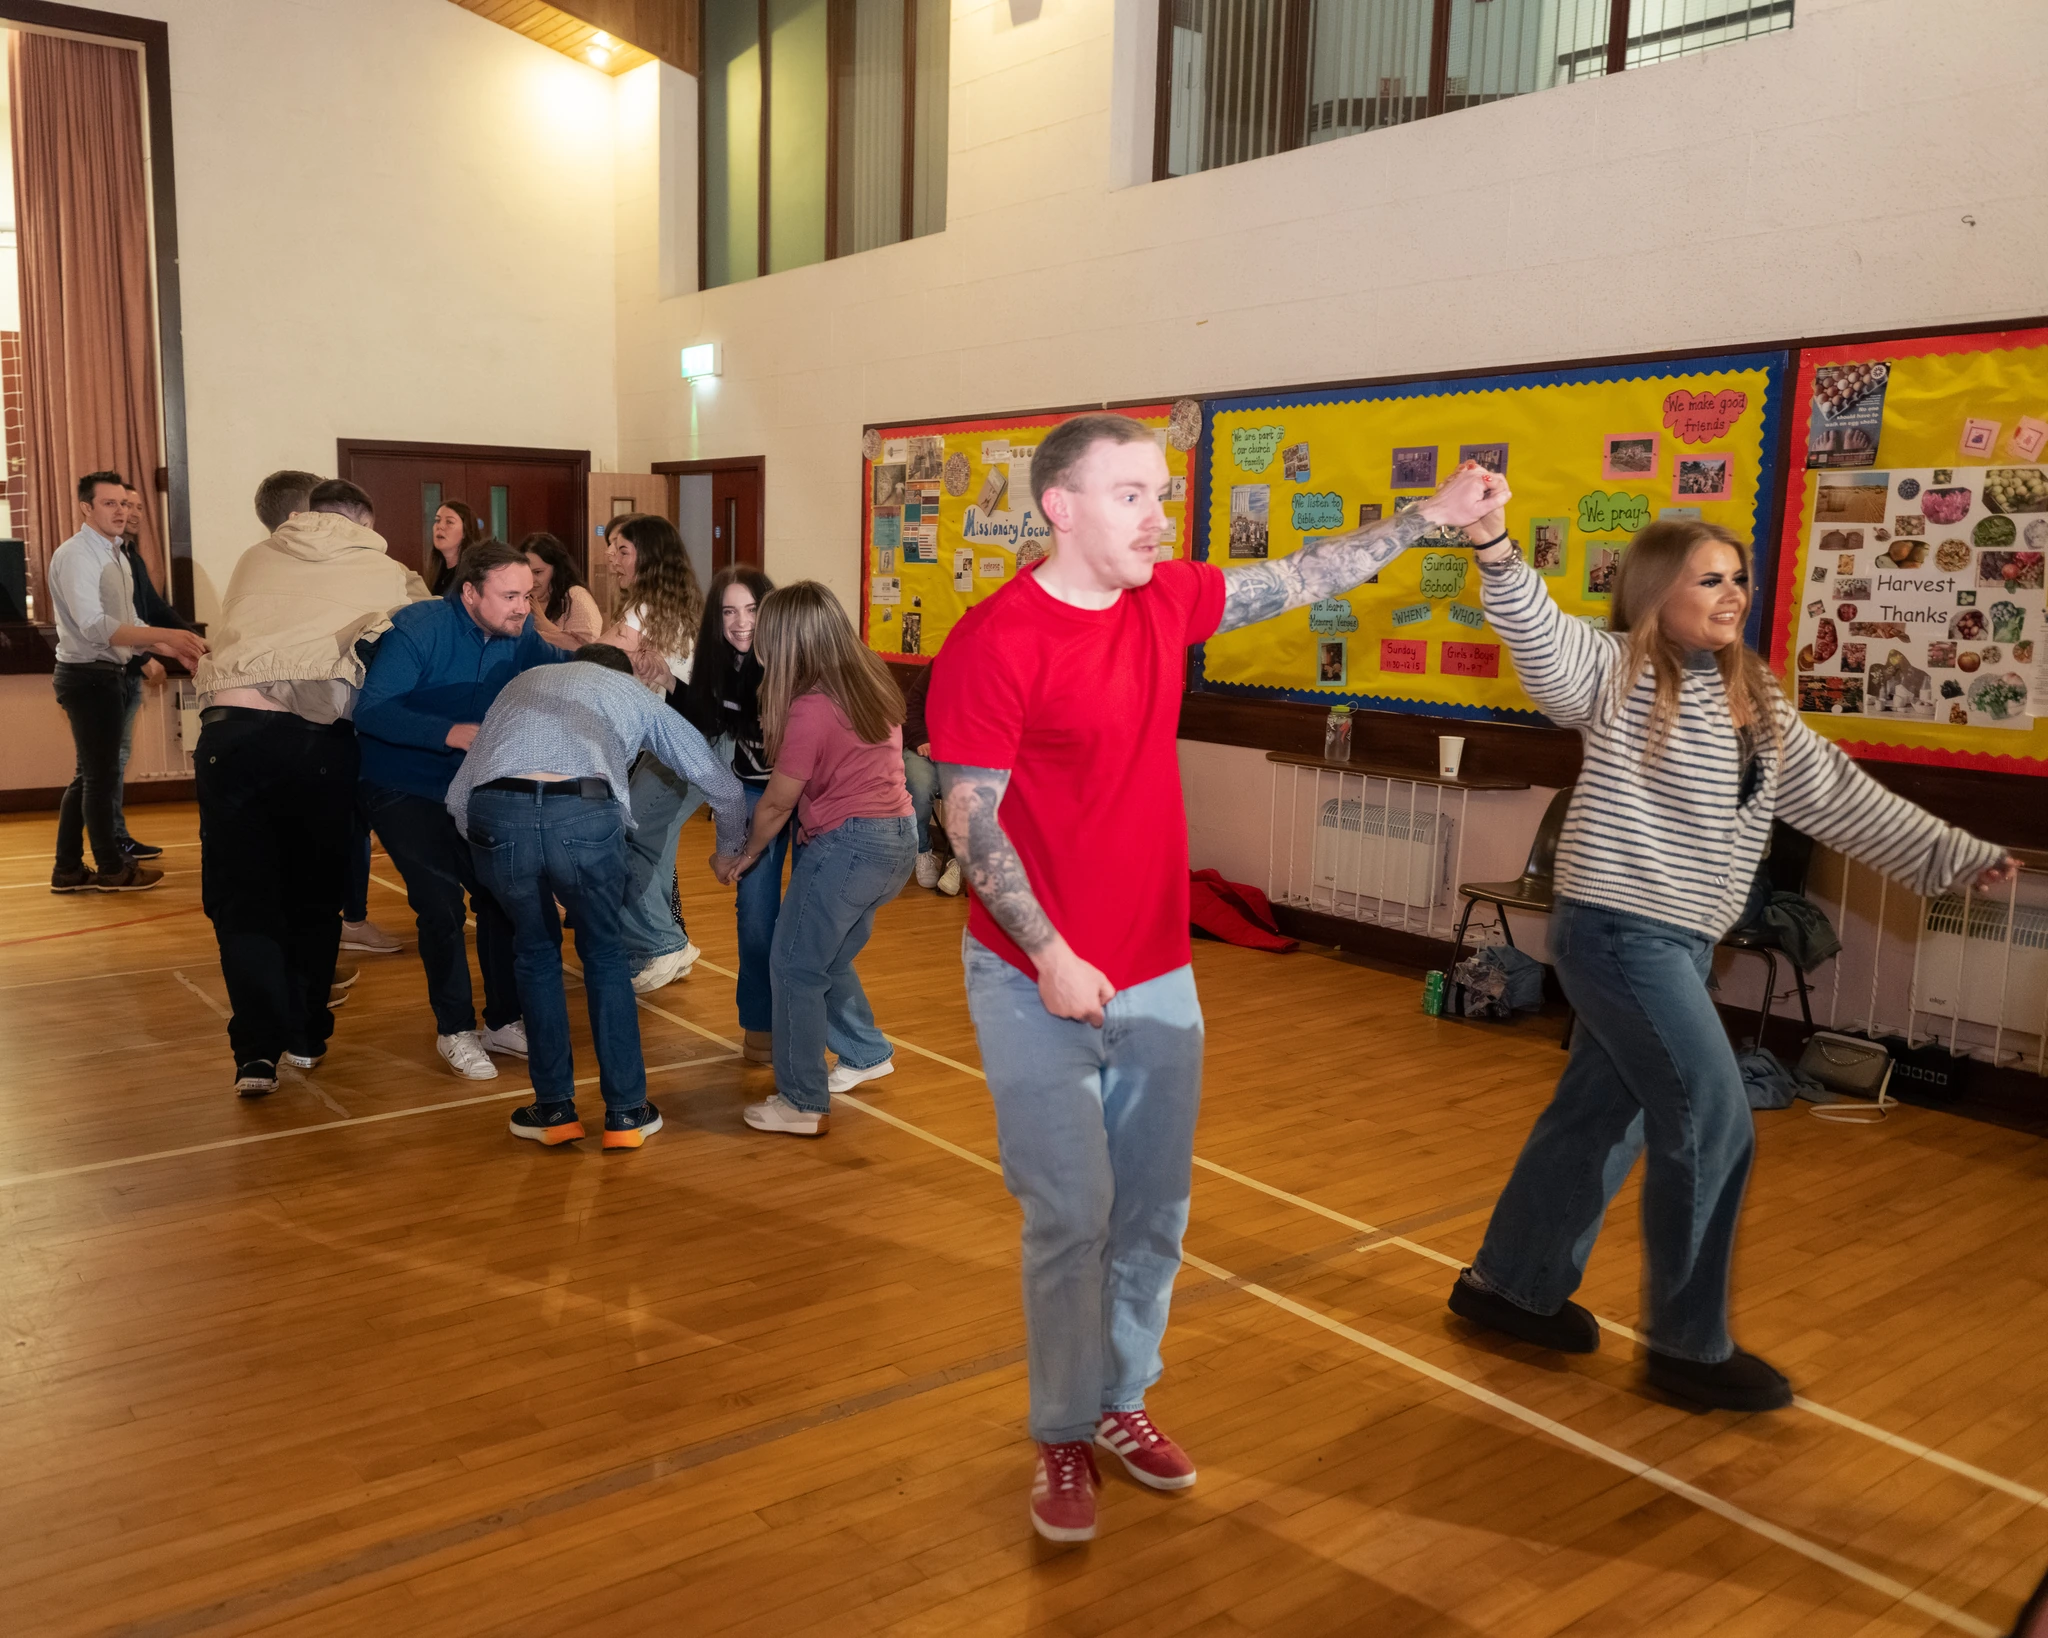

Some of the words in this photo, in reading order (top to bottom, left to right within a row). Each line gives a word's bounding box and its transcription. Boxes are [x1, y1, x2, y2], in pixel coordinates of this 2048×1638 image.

[1667, 395, 1684, 412] We
[1688, 394, 1715, 411] make
[1719, 392, 1745, 414] good
[1684, 418, 1725, 432] friends
[1233, 430, 1242, 442] We
[1245, 432, 1256, 441] are
[1258, 429, 1274, 444] part
[1237, 447, 1248, 455] our
[1249, 443, 1271, 454] church
[1244, 457, 1265, 470] family
[1294, 496, 1305, 509] We
[1307, 495, 1329, 508] listen
[1331, 496, 1341, 508] to
[1297, 512, 1316, 525] Bible
[1317, 512, 1343, 523] stories
[1585, 500, 1605, 522] We
[1611, 508, 1641, 531] pray
[963, 508, 1019, 545] Missionary
[1424, 556, 1465, 578] Sunday
[1423, 577, 1457, 593] School
[1877, 574, 1956, 593] Harvest
[1326, 599, 1345, 612] learn
[1879, 605, 1948, 624] Thanks
[1310, 614, 1333, 630] Memory
[1335, 614, 1357, 628] Verses
[1394, 606, 1429, 625] WHEN?
[1452, 605, 1482, 627] WHO?
[1387, 642, 1416, 660] Sunday
[1447, 645, 1467, 659] Girls
[1474, 647, 1494, 665] Boys
